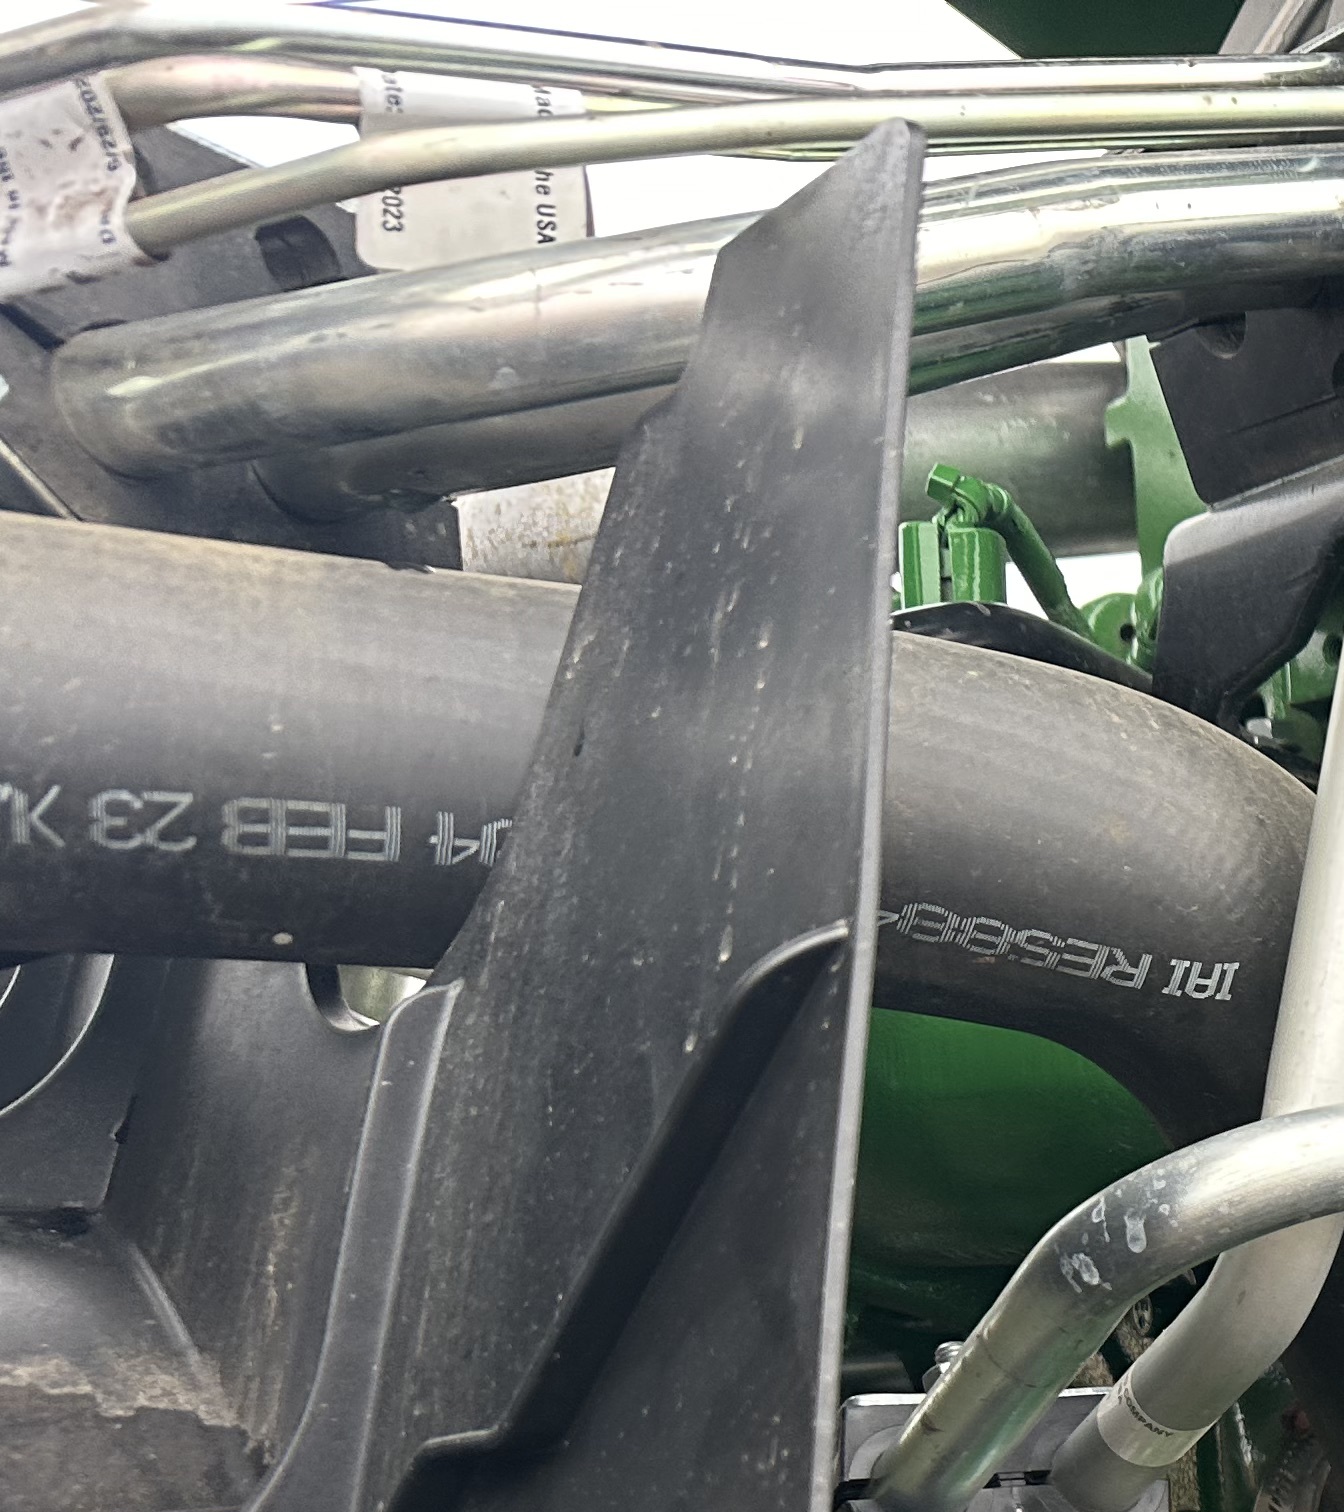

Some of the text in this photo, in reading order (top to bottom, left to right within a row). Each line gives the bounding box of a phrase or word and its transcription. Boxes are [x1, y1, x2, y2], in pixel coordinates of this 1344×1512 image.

[536, 203, 557, 245] USA
[89, 789, 197, 851] 23
[222, 797, 401, 862] FEB
[1123, 1387, 1174, 1437] COMPANY
